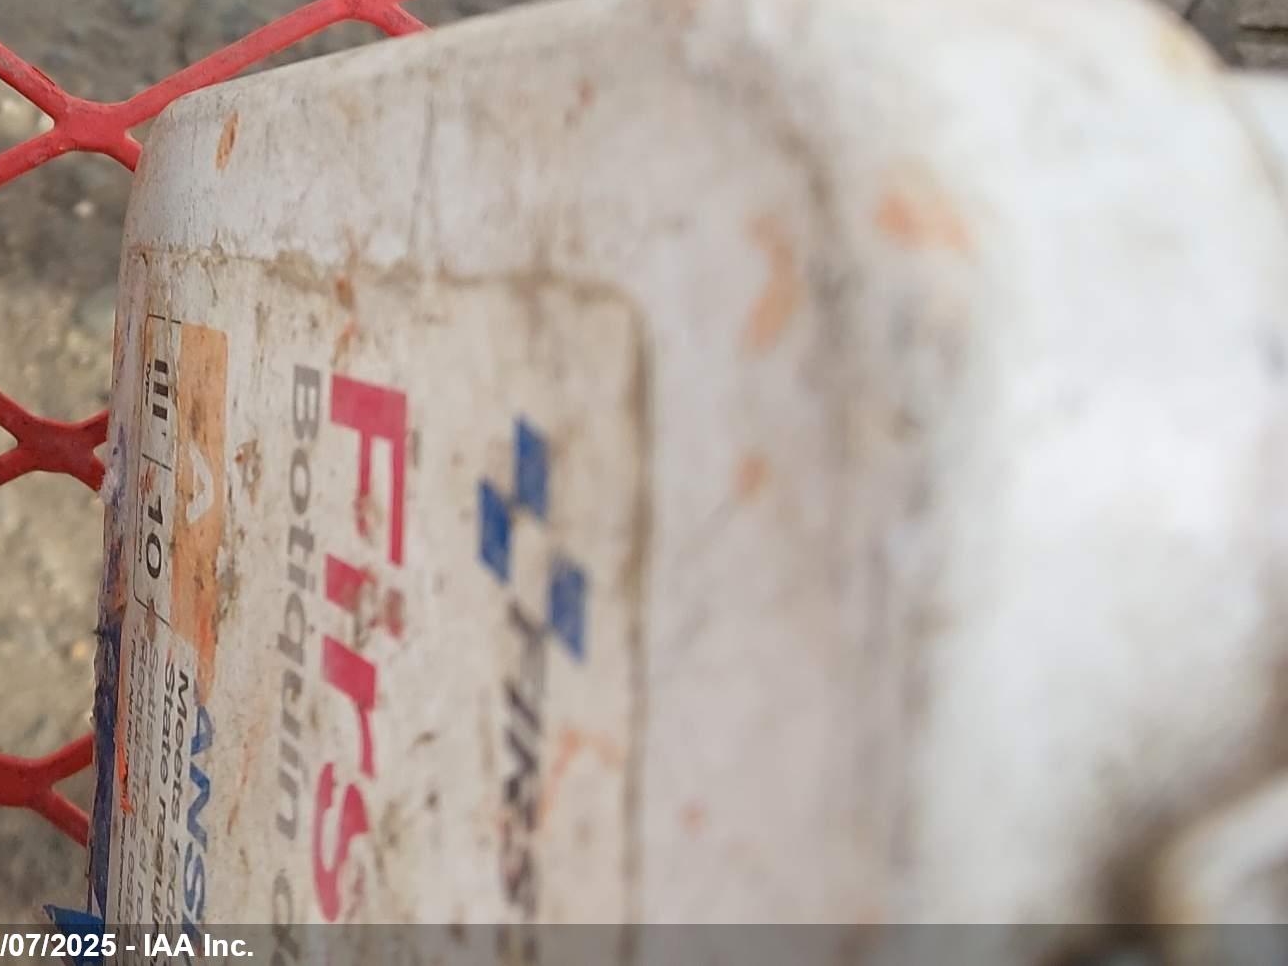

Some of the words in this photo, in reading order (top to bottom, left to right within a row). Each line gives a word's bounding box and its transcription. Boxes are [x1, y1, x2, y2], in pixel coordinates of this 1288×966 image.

[146, 494, 163, 580] 10
[275, 363, 322, 843] Botiquín
[160, 659, 176, 785] State
[170, 669, 189, 822] Meets
[164, 838, 182, 966] fede
